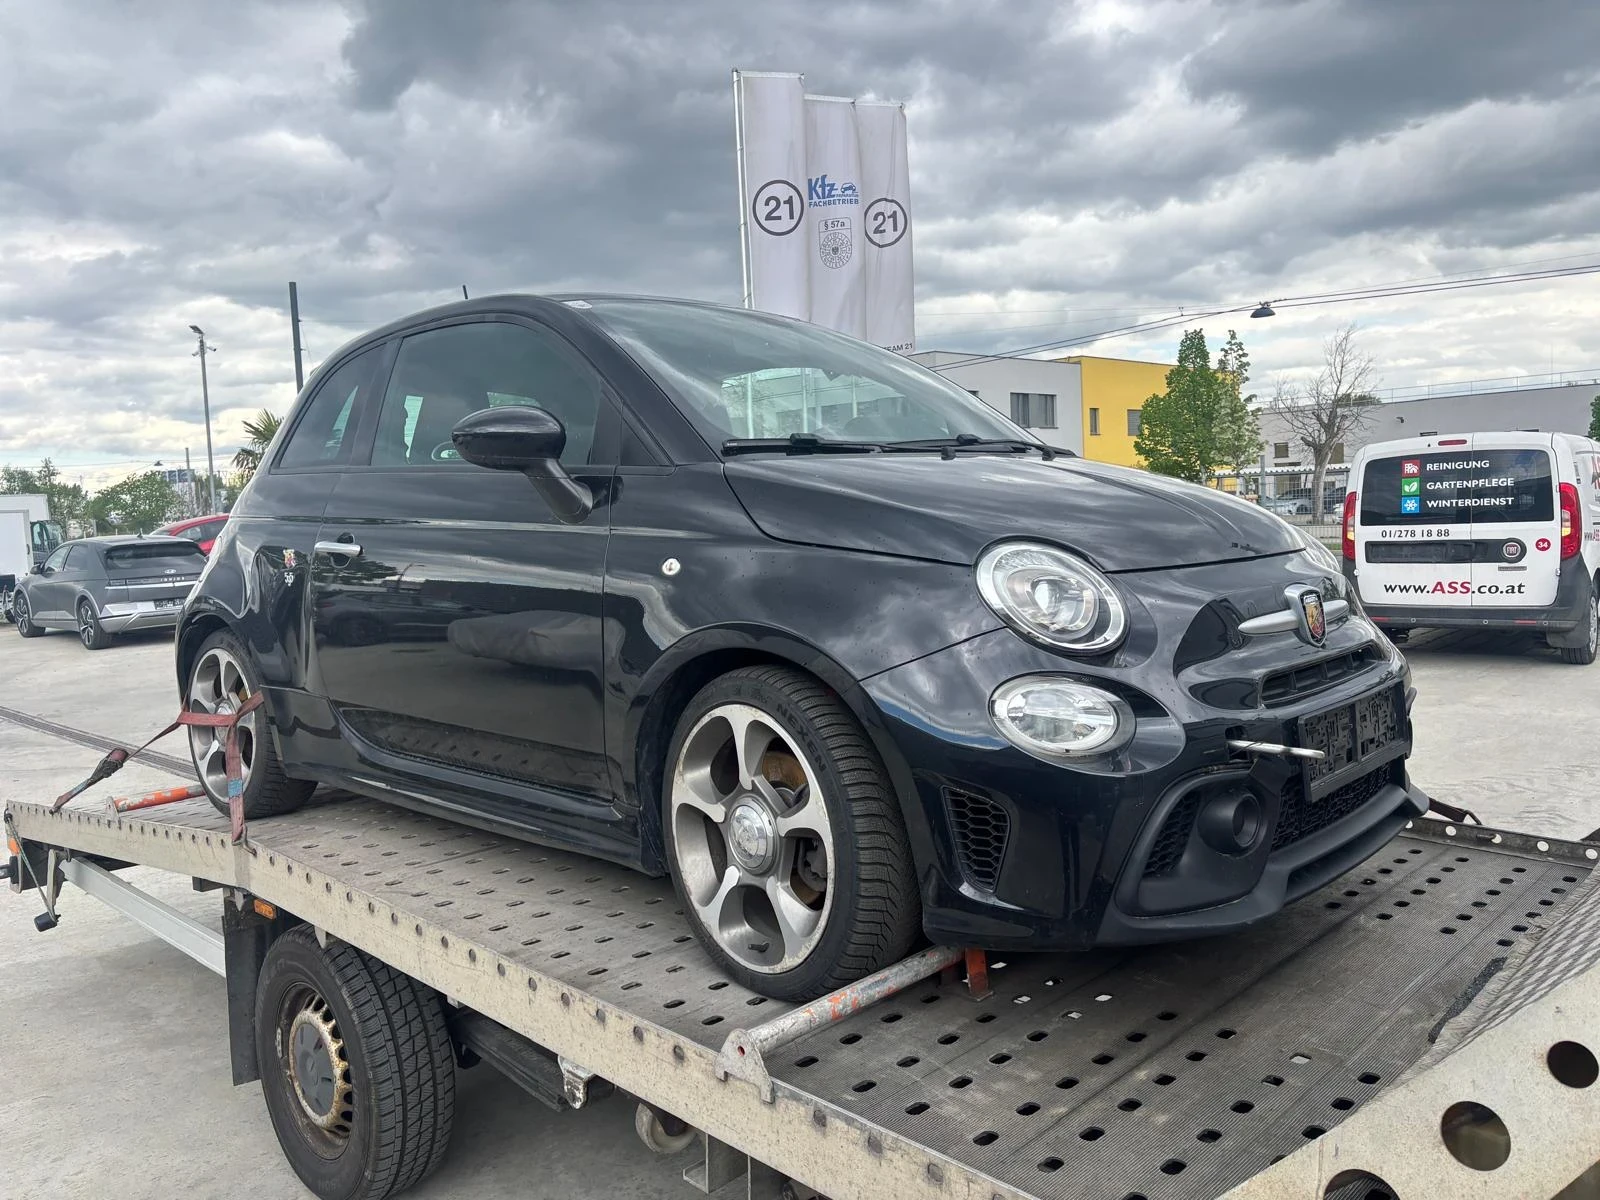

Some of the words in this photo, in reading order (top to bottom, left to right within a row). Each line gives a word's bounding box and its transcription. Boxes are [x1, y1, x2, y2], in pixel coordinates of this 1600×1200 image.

[807, 174, 838, 201] Kfz
[764, 195, 795, 221] 21
[808, 198, 859, 209] FACHBETRIEB
[831, 220, 845, 228] 57a
[872, 210, 898, 235] 21
[905, 342, 913, 350] 21
[1426, 460, 1490, 471] REINIGUNG
[1426, 478, 1515, 490] GARTENPFLEGE
[1426, 497, 1515, 508] WINTERDIENST
[1381, 529, 1416, 539] 01/278
[1421, 529, 1433, 538] 18
[1436, 528, 1450, 537] 88
[1384, 581, 1526, 595] www.ASS.co.at
[776, 703, 828, 774] NEXEN
